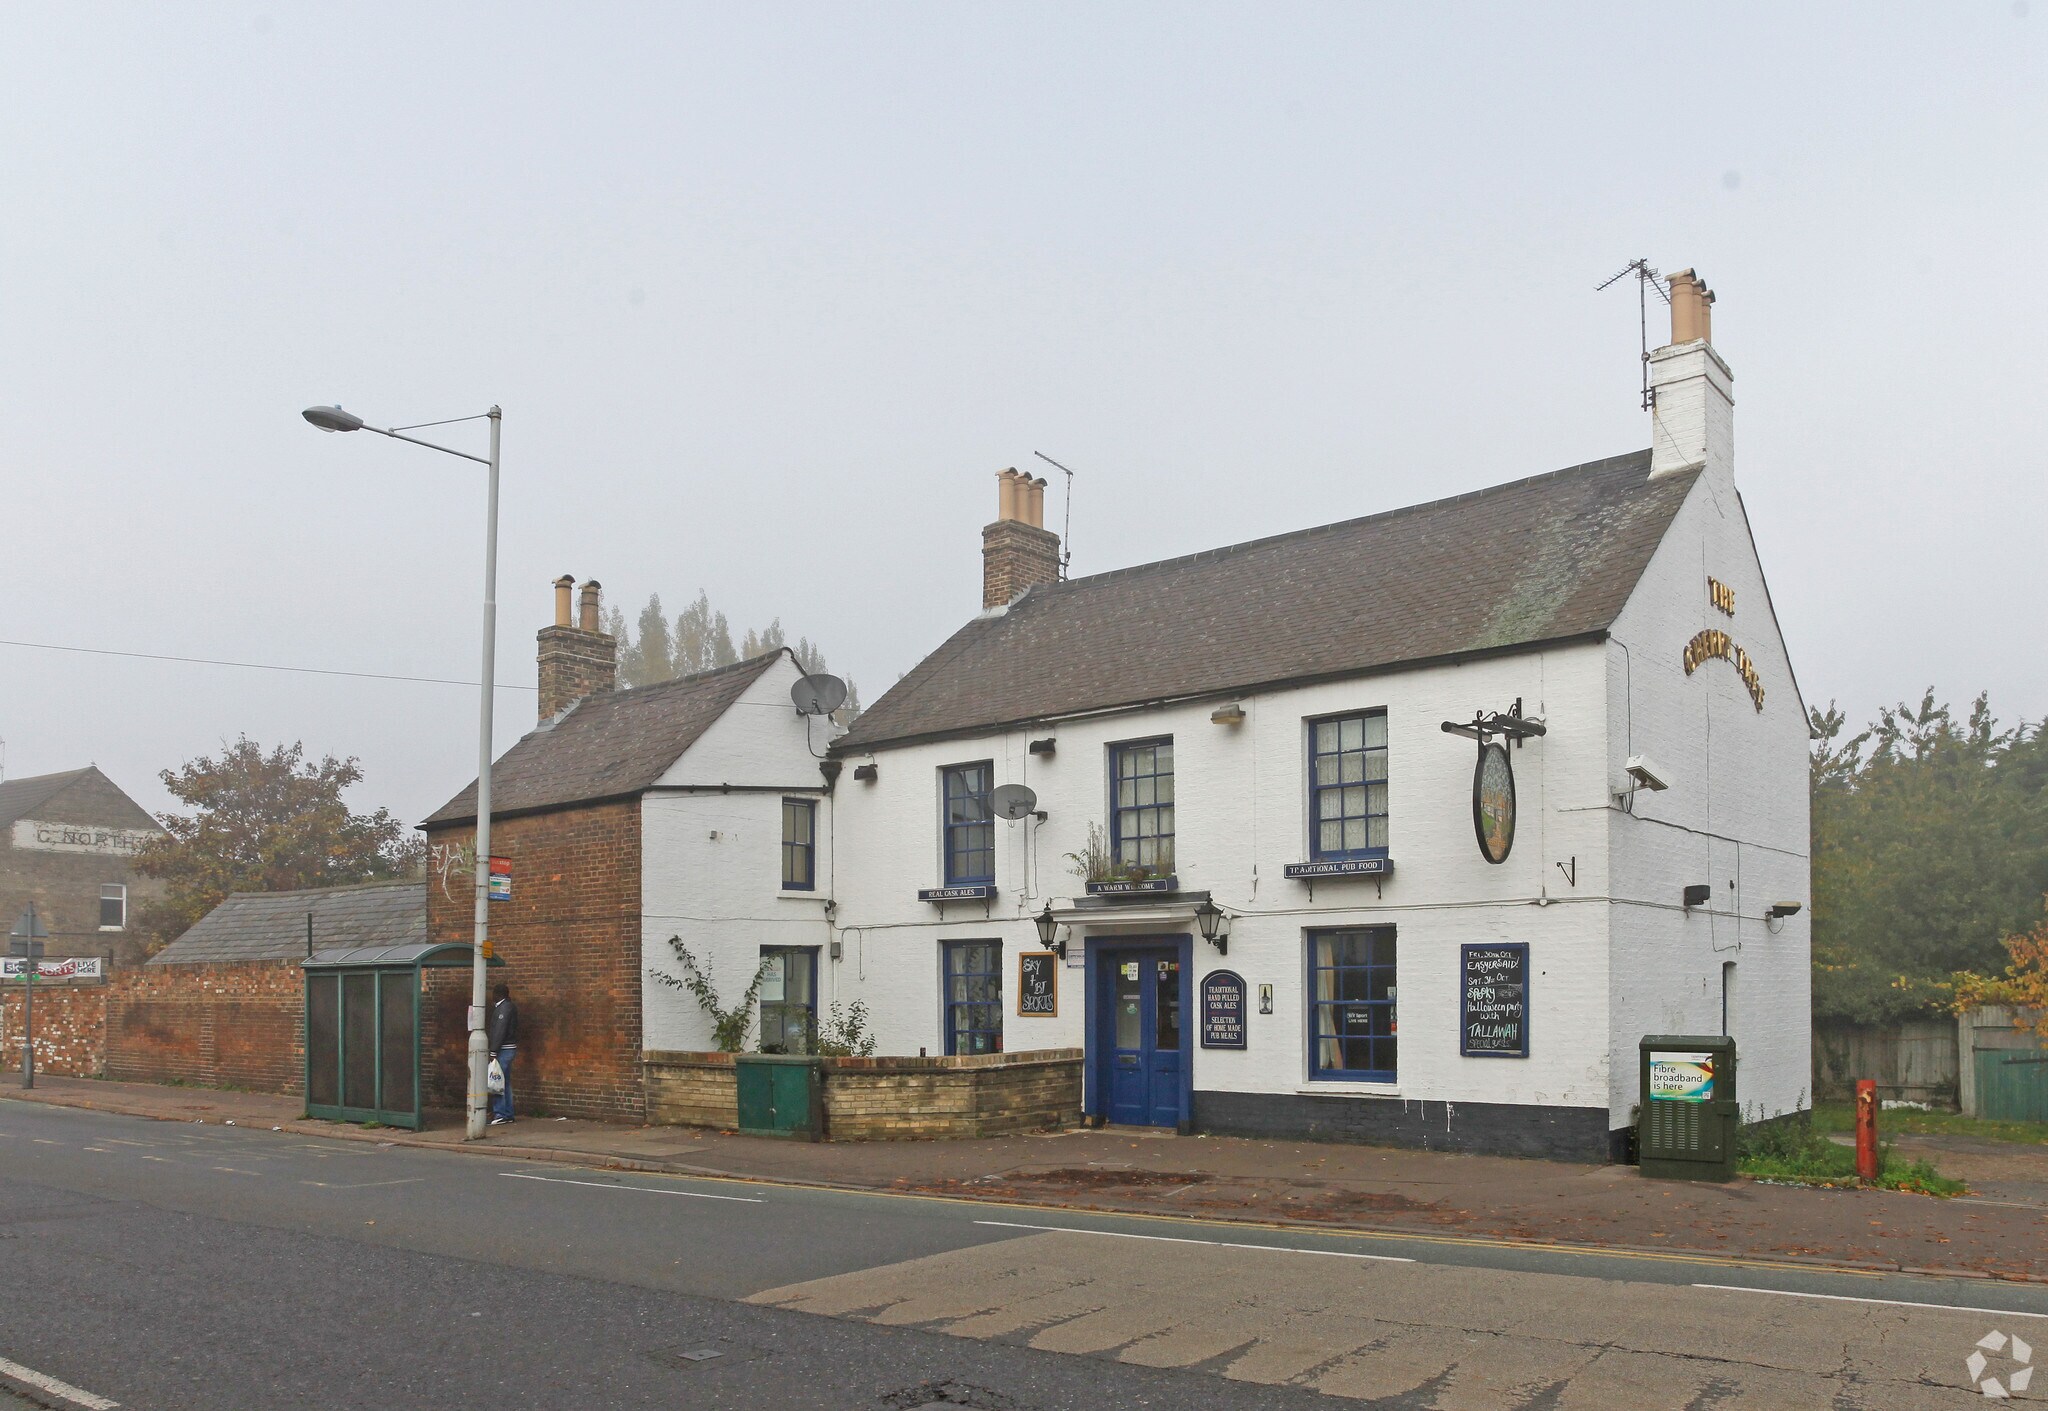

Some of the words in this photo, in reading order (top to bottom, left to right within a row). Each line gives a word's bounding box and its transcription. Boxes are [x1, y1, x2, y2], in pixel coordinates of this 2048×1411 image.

[1707, 576, 1735, 618] THE
[1341, 863, 1356, 871] PUB
[1358, 861, 1378, 870] FOOD
[928, 890, 943, 898] REAL
[944, 889, 958, 897] CASK
[960, 888, 975, 896] ALES
[1654, 1064, 1676, 1073] Fibre
[1654, 1073, 1703, 1082] broadband
[1663, 1082, 1683, 1090] here
